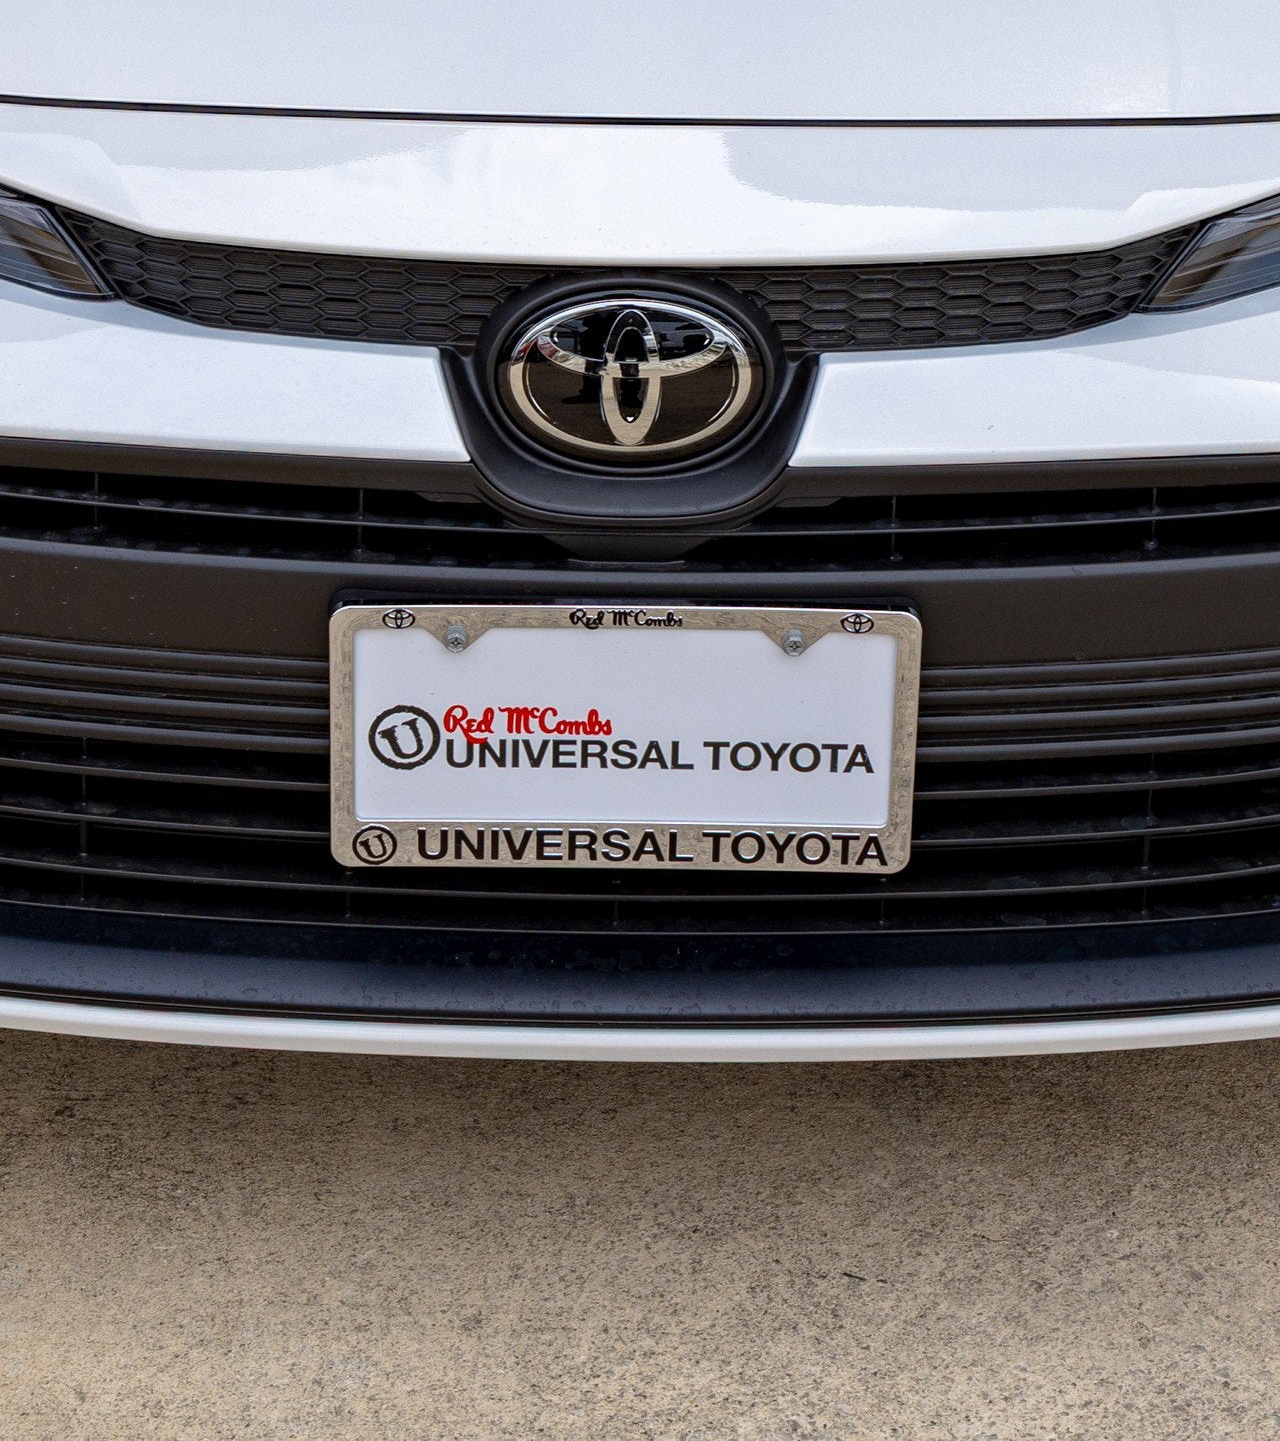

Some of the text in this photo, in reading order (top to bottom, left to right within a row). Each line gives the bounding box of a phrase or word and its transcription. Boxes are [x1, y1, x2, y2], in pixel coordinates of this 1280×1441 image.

[569, 607, 684, 630] Red McCombs
[443, 704, 613, 744] Red McCombs
[445, 738, 874, 774] UNIVERSAL TOYOTA
[417, 827, 888, 866] UNIVERSAL TOYOTA
